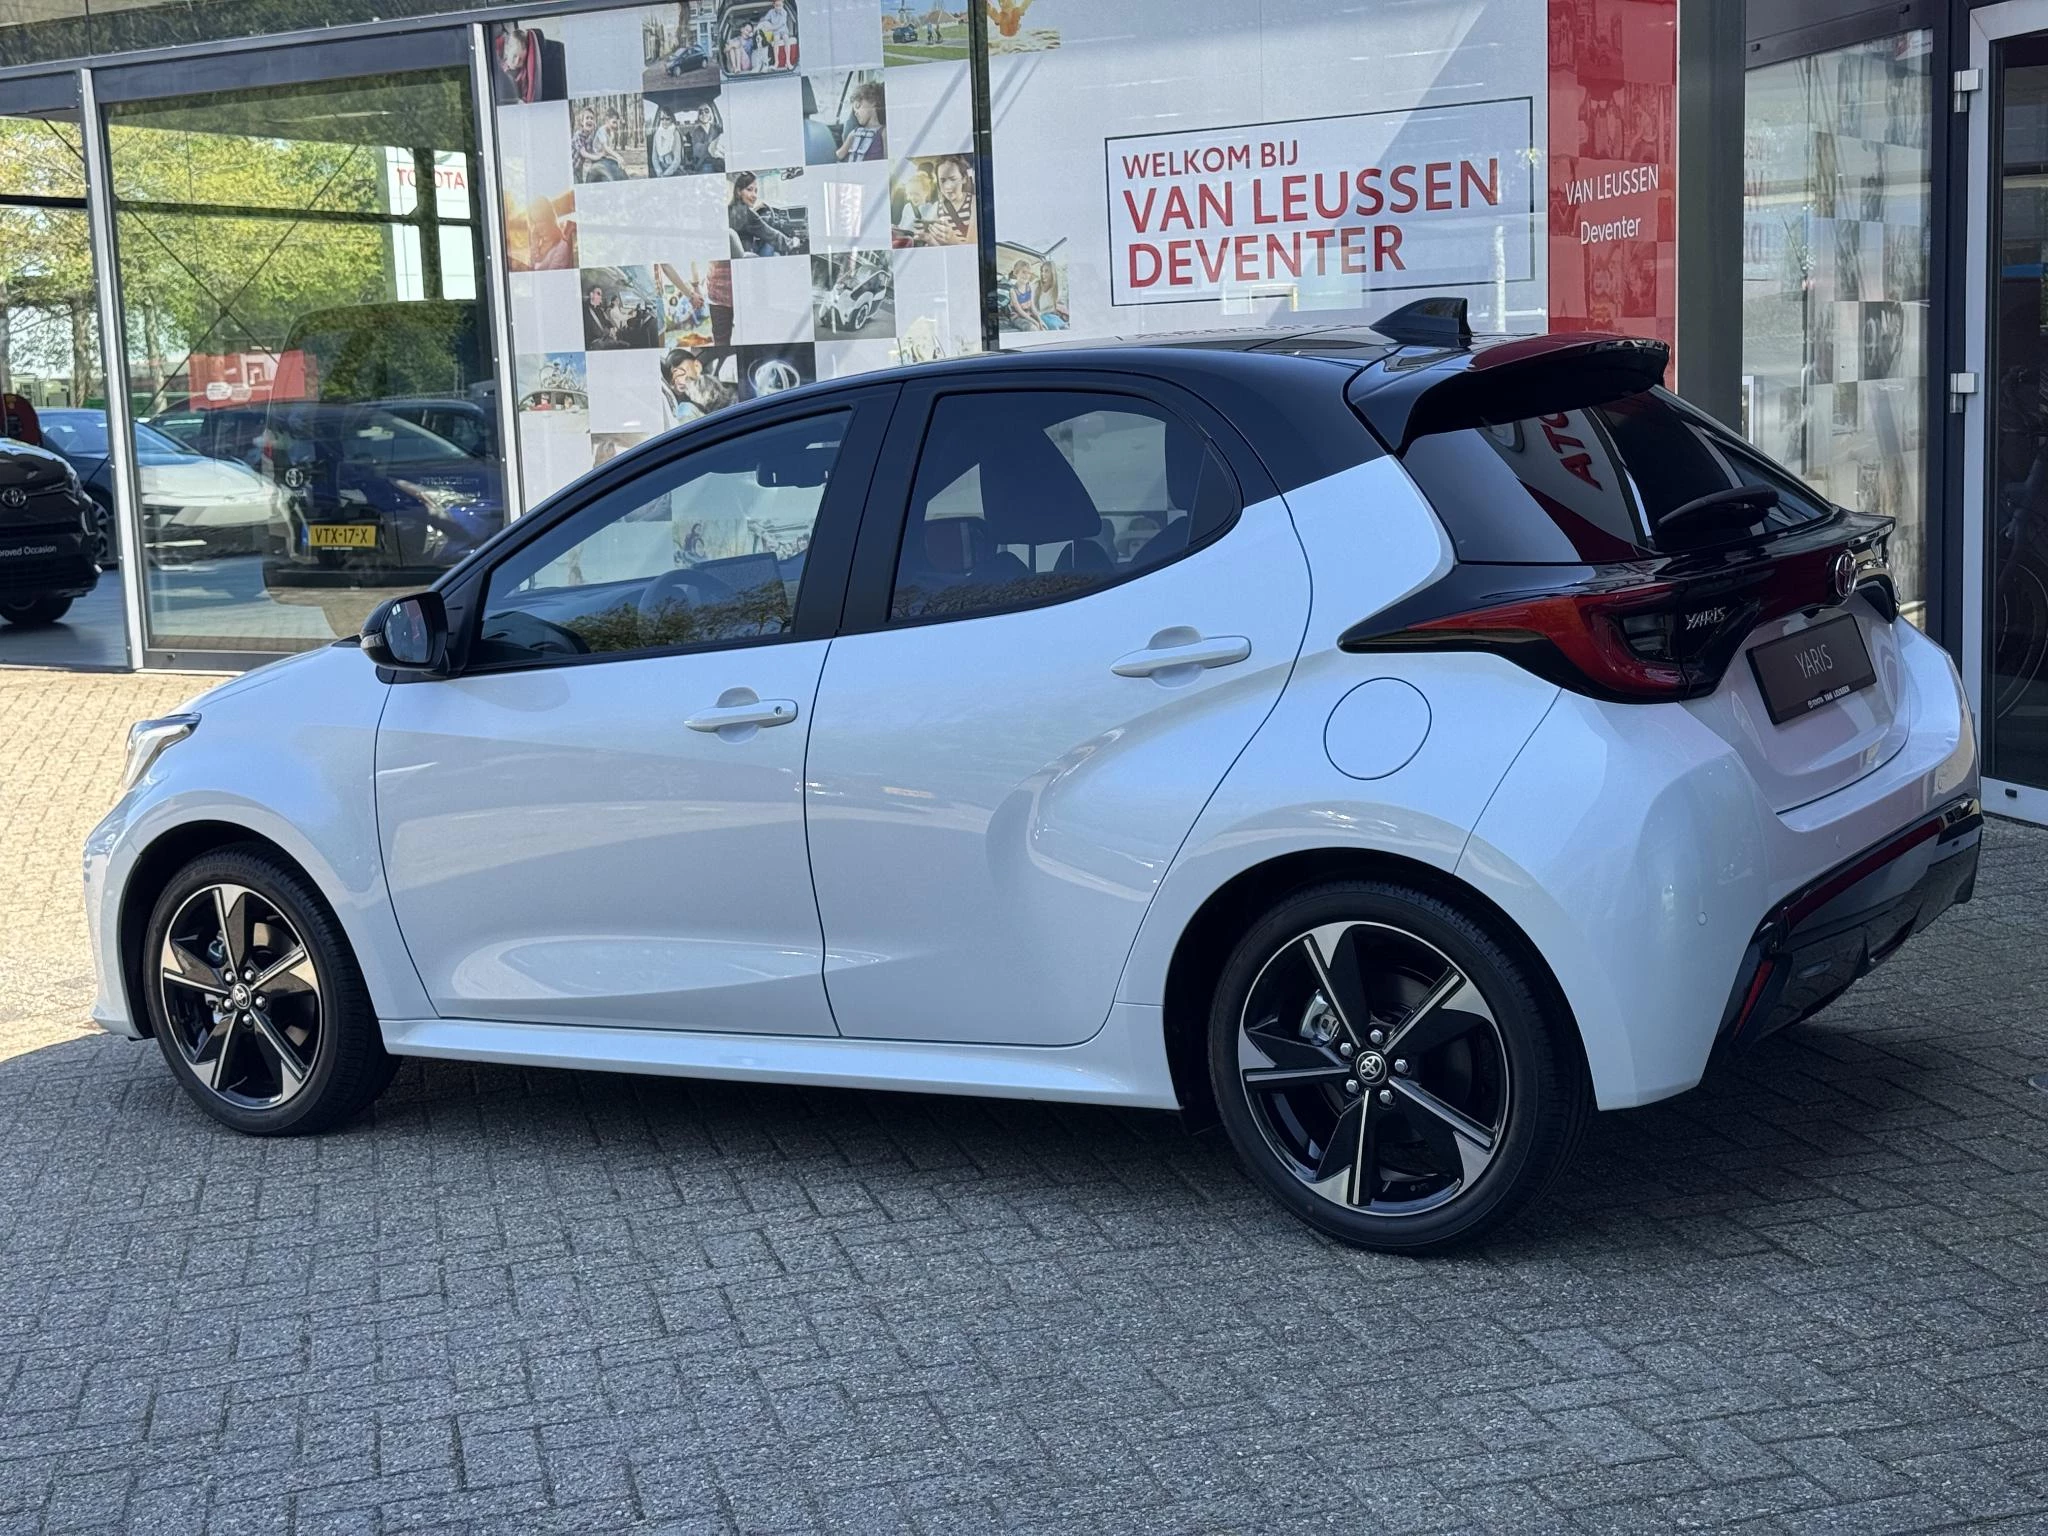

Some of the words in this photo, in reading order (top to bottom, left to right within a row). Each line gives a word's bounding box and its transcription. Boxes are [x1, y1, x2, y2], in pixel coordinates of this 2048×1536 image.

[1122, 144, 1250, 179] WELKOM
[1260, 140, 1298, 168] BIJ
[397, 168, 466, 189] TOOTA
[1565, 178, 1593, 206] VAN
[1597, 164, 1658, 200] LEUSSEN
[1123, 181, 1234, 233] VAN
[1253, 158, 1498, 224] LEUSSEN
[1580, 215, 1641, 245] Deventer
[1128, 225, 1406, 288] DEVENTER
[23, 545, 57, 555] Occasion
[315, 528, 368, 544] VTX-17-X
[1685, 606, 1727, 630] YARIS
[1794, 643, 1833, 679] YARIS
